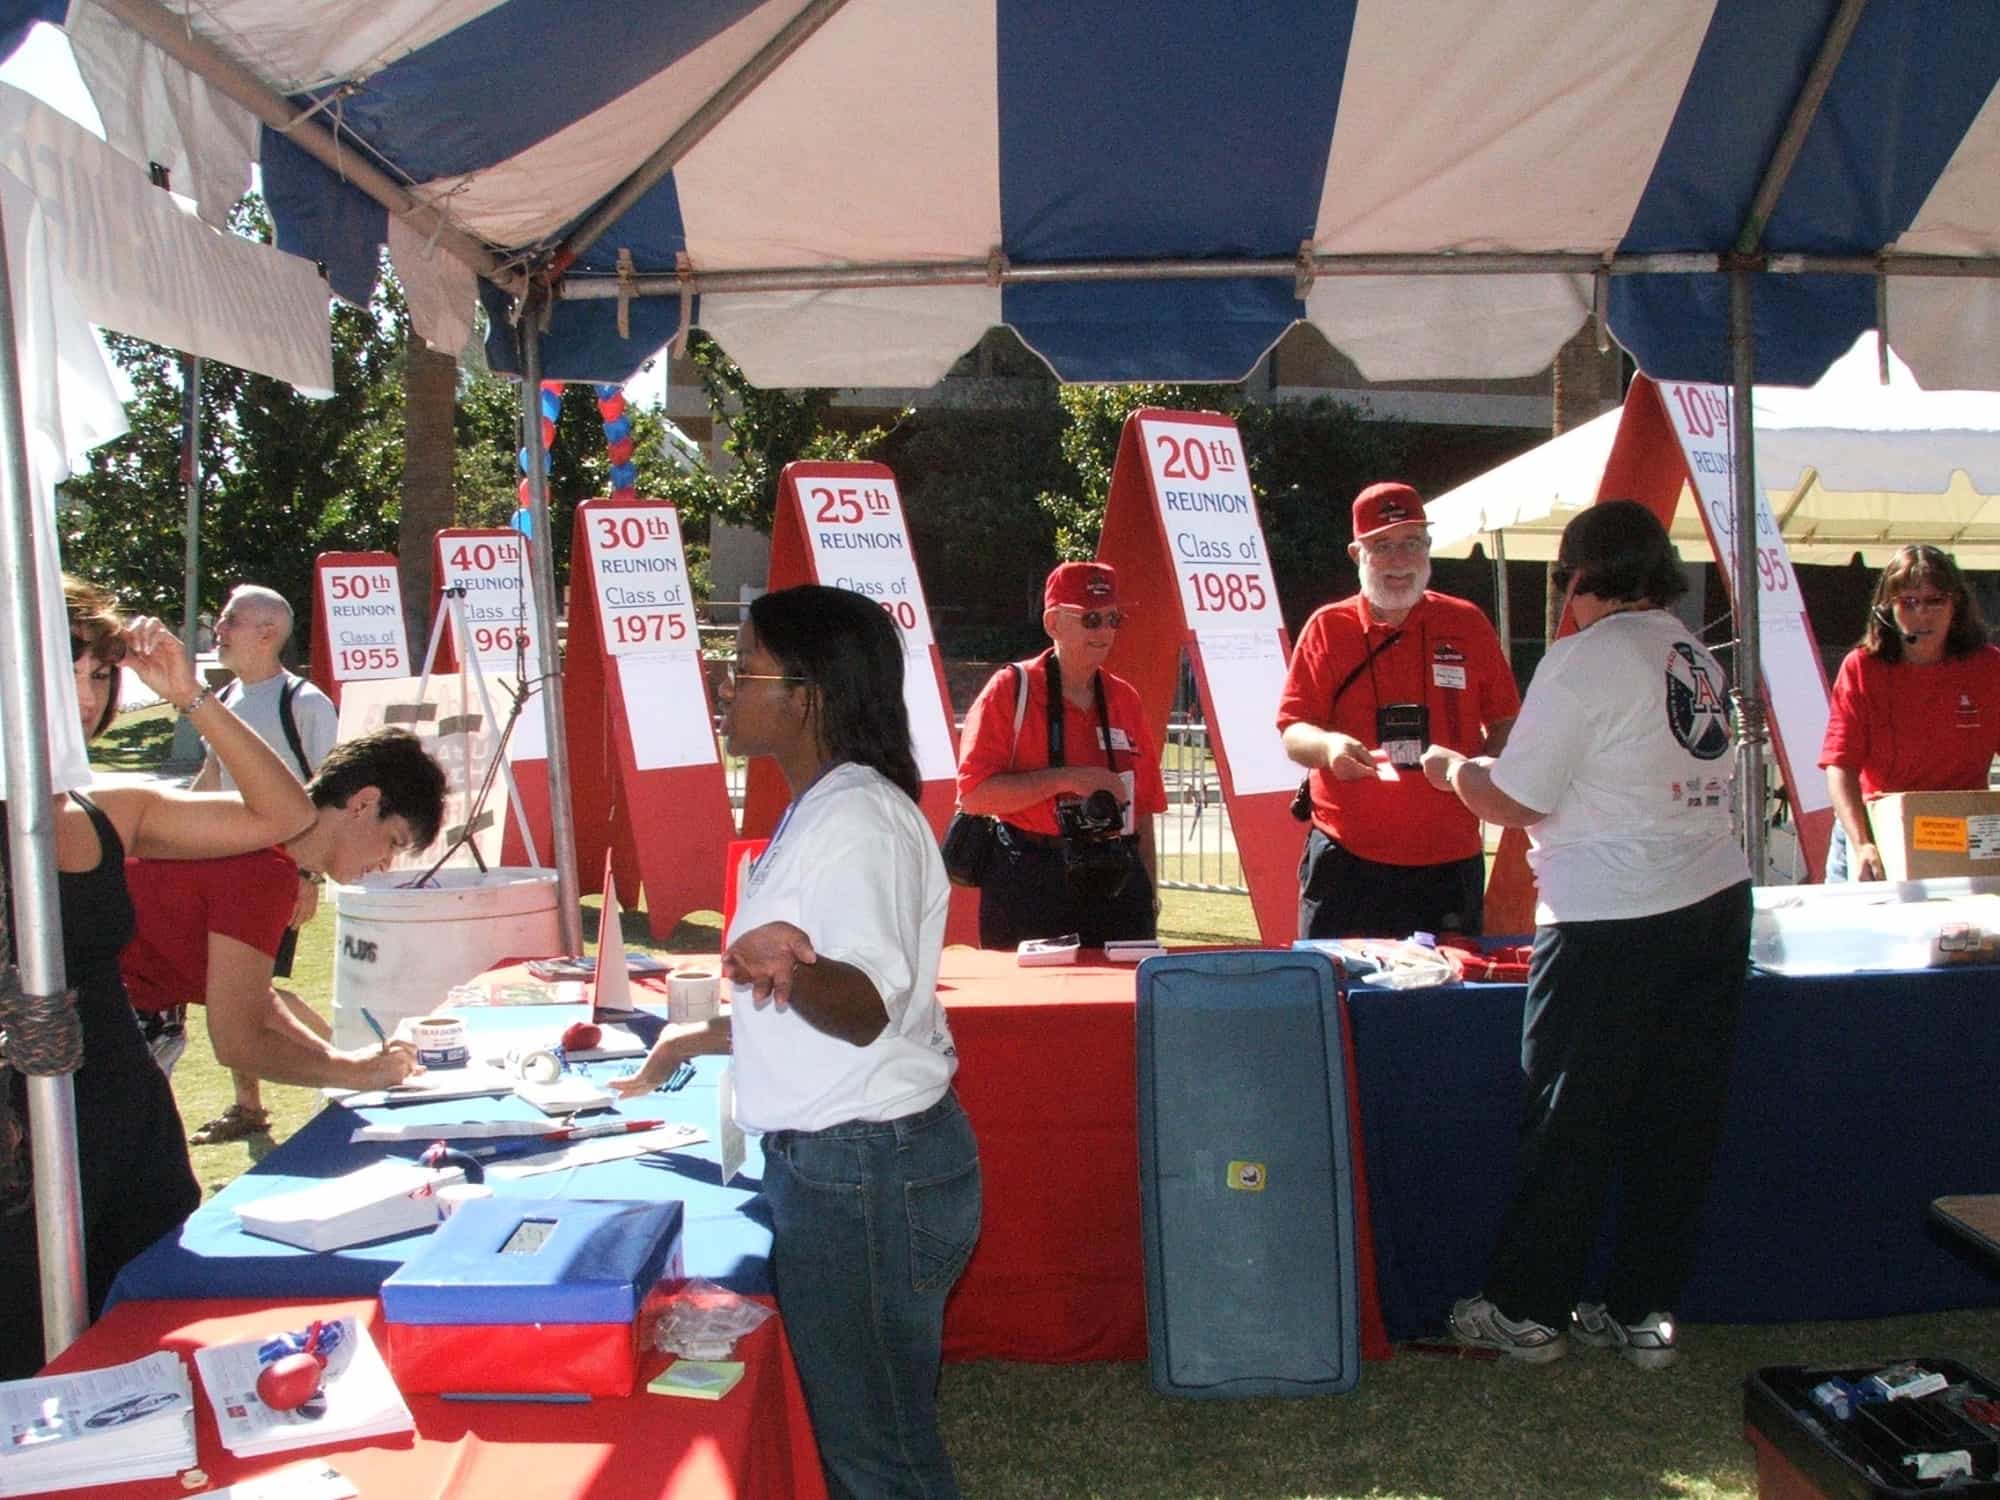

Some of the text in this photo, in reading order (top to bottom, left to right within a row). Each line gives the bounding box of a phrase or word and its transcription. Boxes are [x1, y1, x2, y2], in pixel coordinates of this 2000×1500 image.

[1673, 385, 1729, 438] 10th
[1157, 435, 1236, 481] 20th
[1692, 450, 1737, 474] REUN
[811, 487, 890, 524] 25th
[1165, 491, 1249, 514] REUNION
[597, 517, 670, 549] 30th
[819, 532, 903, 549] REUNION
[451, 544, 519, 571] 40th
[1177, 532, 1257, 559] Class of
[601, 558, 678, 573] REUNION
[331, 574, 391, 599] 50th
[453, 577, 523, 590] REUNION
[605, 585, 681, 605] Class of
[835, 577, 908, 594] Class of
[1188, 572, 1266, 612] 1985
[333, 605, 396, 617] REUNION
[511, 601, 527, 617] of
[340, 630, 394, 645] Class of
[475, 627, 531, 652] 965
[612, 614, 686, 643] 1975
[340, 648, 400, 670] 1955
[1689, 665, 1721, 714] A
